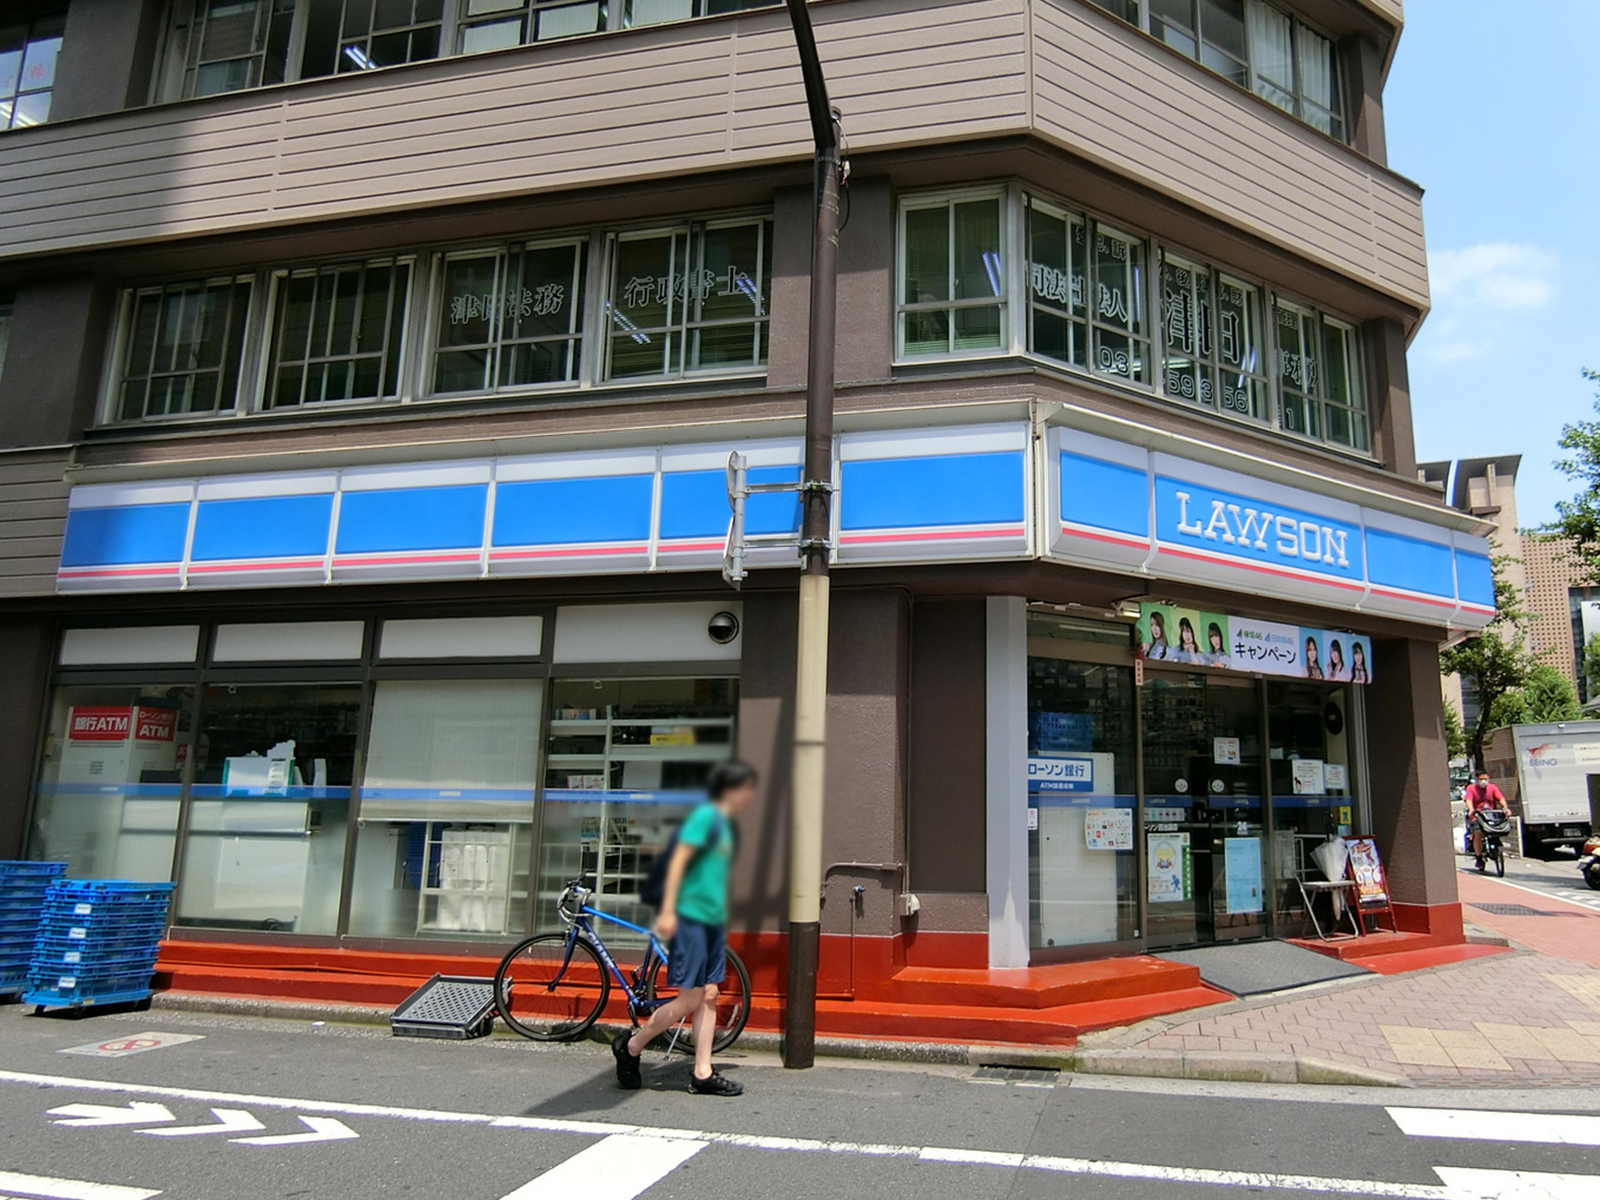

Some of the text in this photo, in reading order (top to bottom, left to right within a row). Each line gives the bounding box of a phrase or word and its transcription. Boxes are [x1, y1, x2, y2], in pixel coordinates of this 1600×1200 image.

[624, 265, 749, 308] 行政書士
[1176, 491, 1350, 568] LAWSON
[1235, 642, 1297, 664] キャンペーン
[75, 716, 128, 732] 銀行ATM
[139, 725, 170, 738] ATM
[1027, 763, 1085, 778] ローソン銀行
